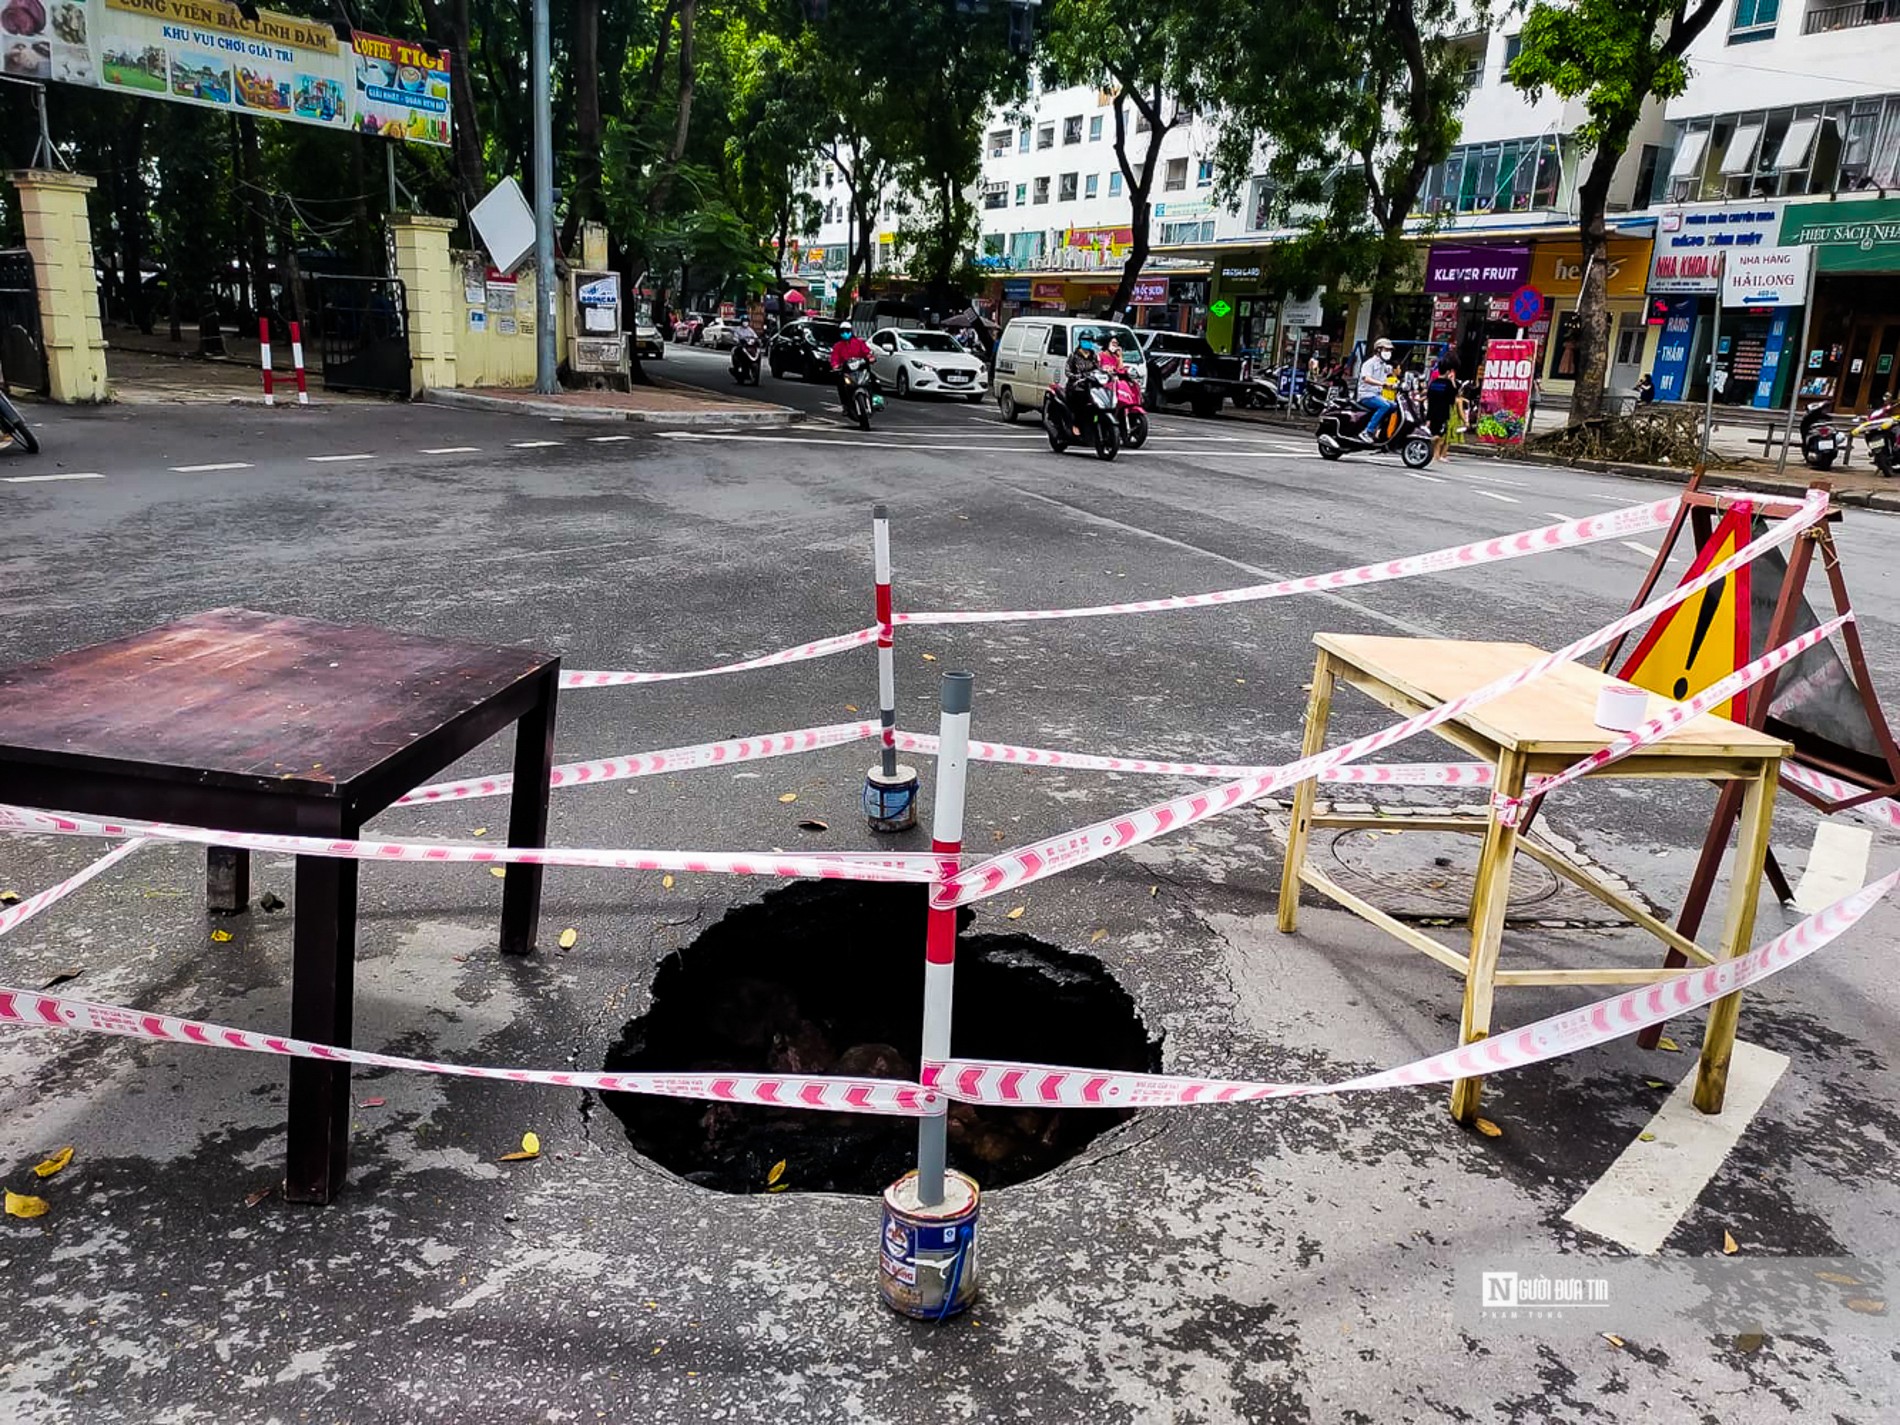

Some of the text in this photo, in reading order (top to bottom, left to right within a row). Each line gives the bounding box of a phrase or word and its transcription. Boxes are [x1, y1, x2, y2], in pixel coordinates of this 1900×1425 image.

[163, 26, 189, 41] KHU
[193, 32, 214, 47] VUI
[217, 37, 245, 53] CHƠI
[254, 19, 290, 40] LINH
[354, 37, 392, 60] COFFEE
[1434, 266, 1519, 281] KLEVER FRUIT
[1484, 359, 1531, 379] NHO
[1482, 378, 1528, 390] AUSTRALIA
